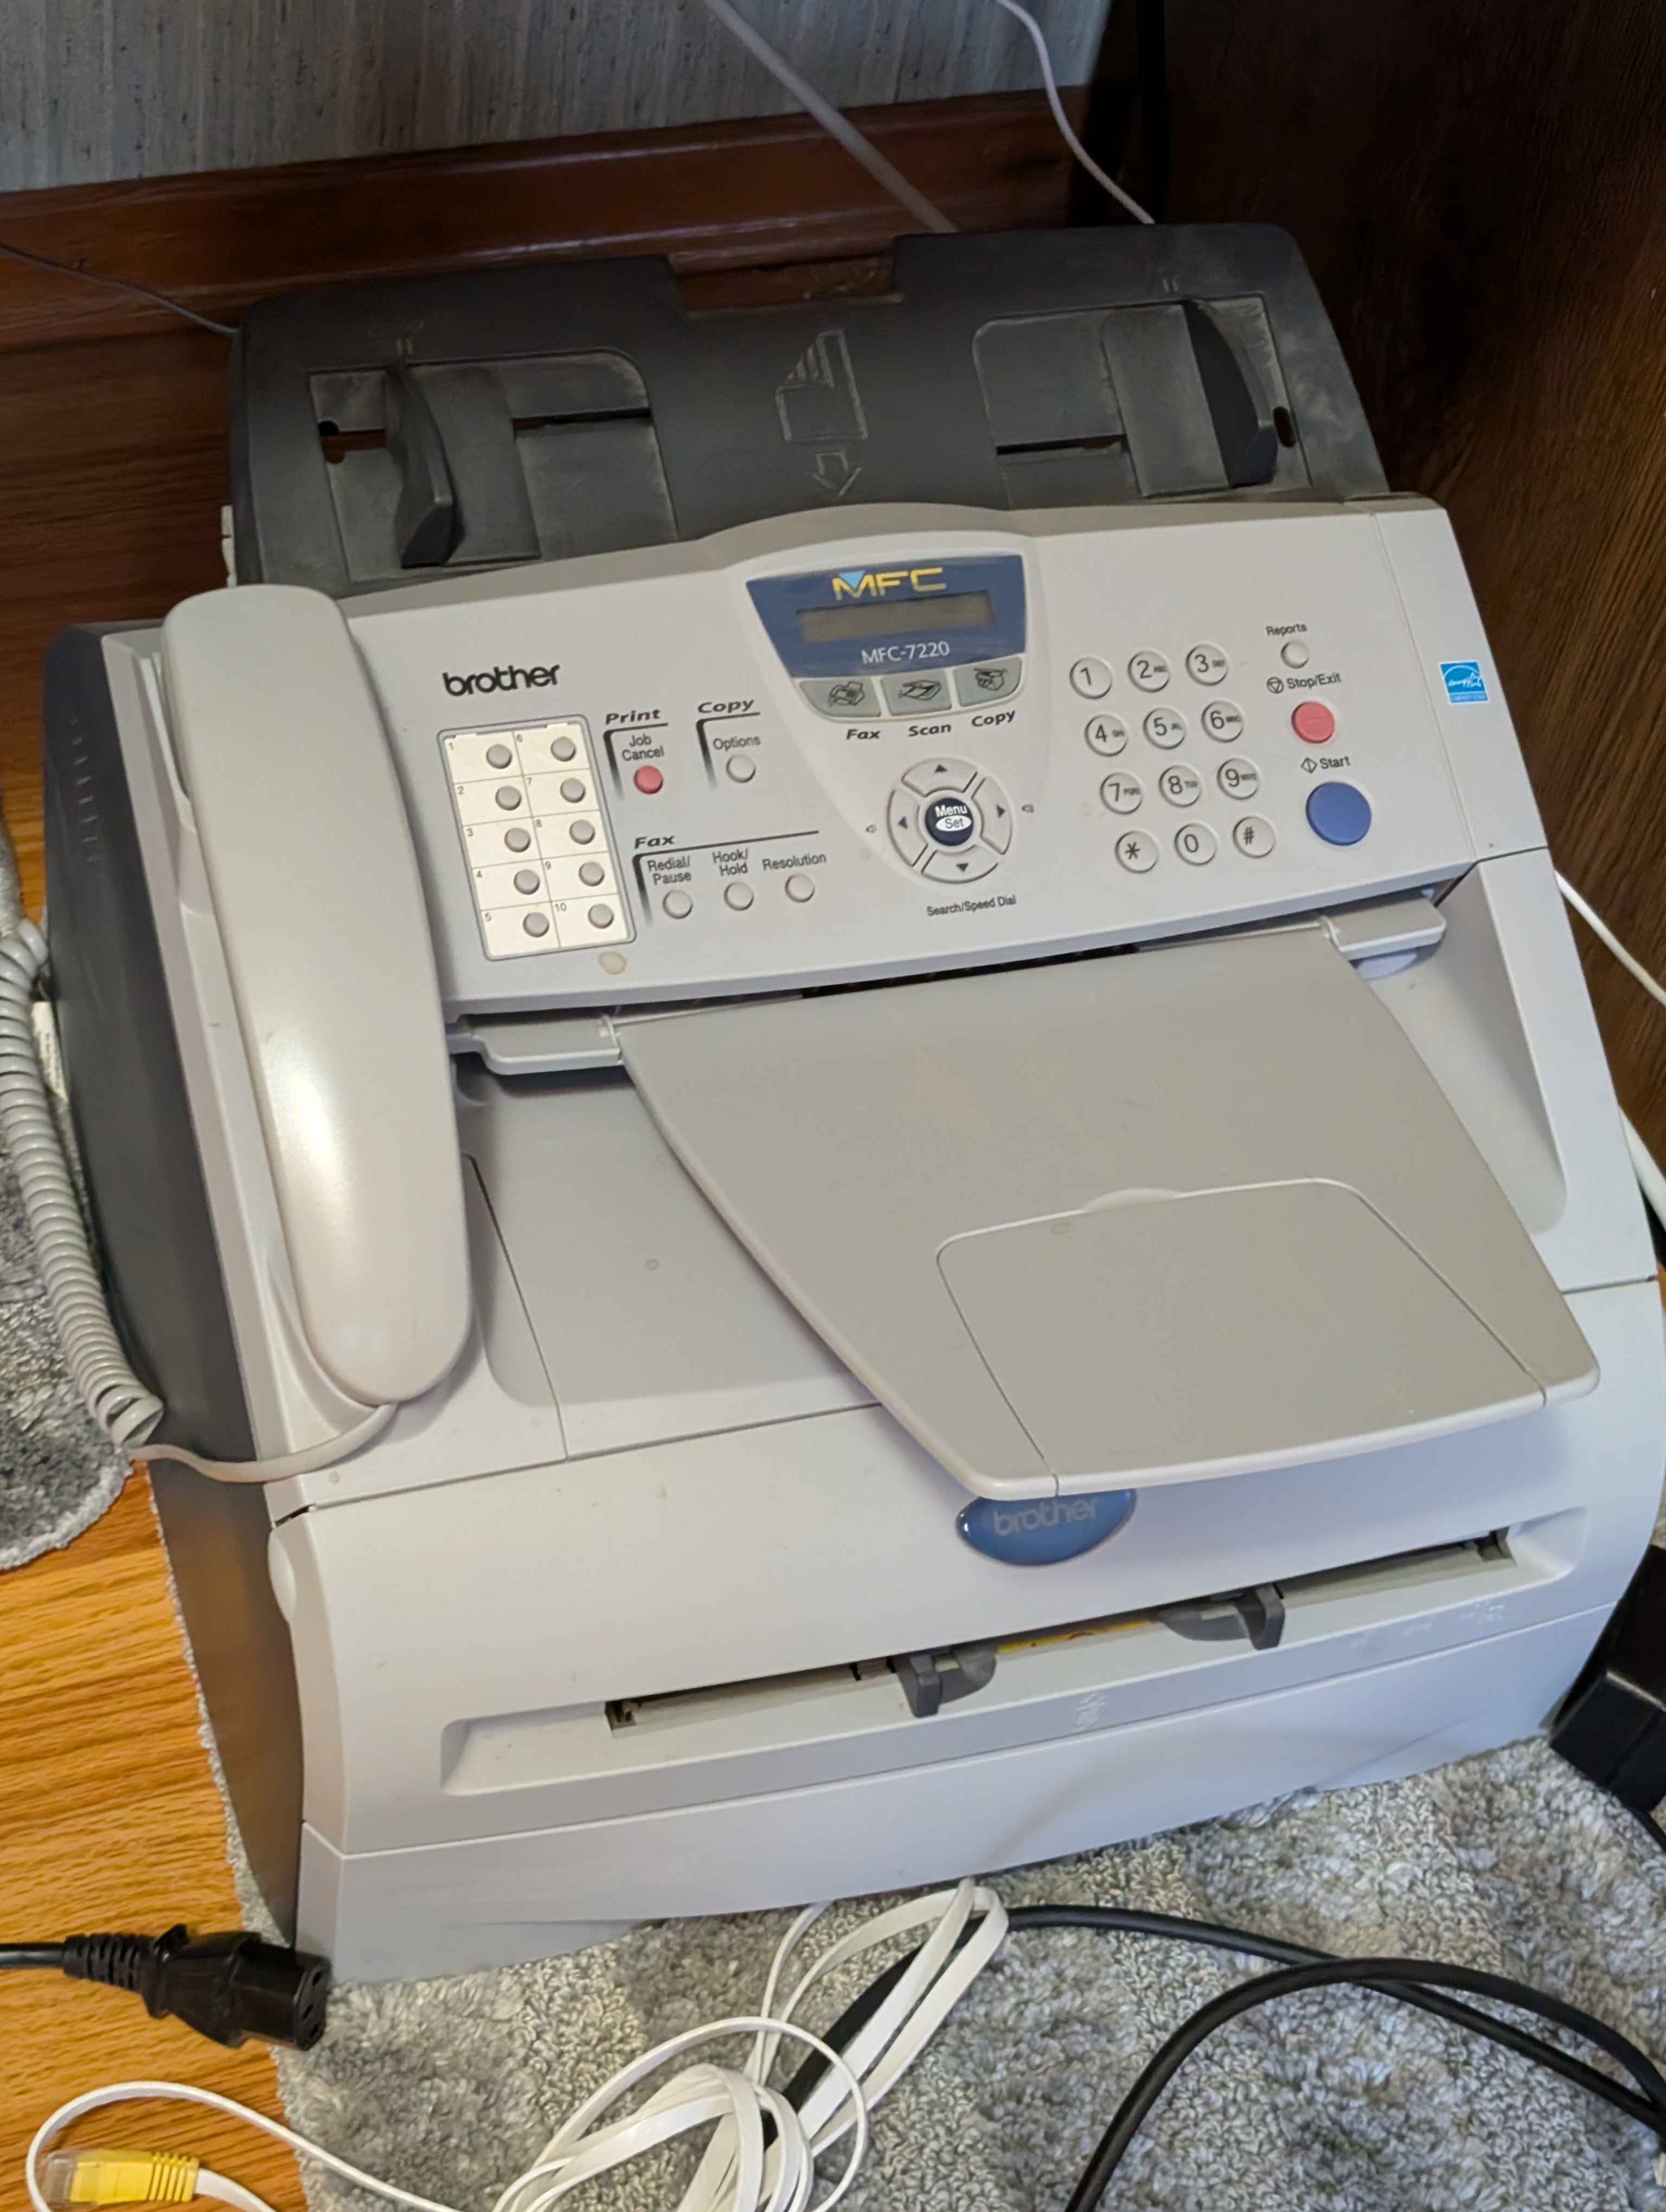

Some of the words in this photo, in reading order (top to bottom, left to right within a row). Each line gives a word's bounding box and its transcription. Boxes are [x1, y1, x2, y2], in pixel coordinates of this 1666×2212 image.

[832, 567, 947, 600] MFC
[1266, 623, 1308, 637] Reports
[861, 641, 950, 665] MFC-7220
[1137, 660, 1152, 678] 2
[1195, 654, 1209, 673] 3
[442, 665, 560, 696] brother
[1080, 667, 1091, 685] 1
[1286, 672, 1342, 690] Stop/Exit
[697, 699, 755, 713] Copy
[605, 709, 662, 725] Print
[971, 710, 1016, 728] Copy
[1210, 711, 1225, 730] 6
[845, 728, 881, 740] Fax
[908, 723, 951, 737] Scan
[1095, 724, 1107, 743] 4
[1154, 717, 1168, 736] 5
[448, 742, 454, 751] 1
[516, 734, 523, 743] 6
[629, 734, 652, 748] Job
[713, 735, 761, 752] Options
[621, 746, 664, 762] Cancel
[1319, 756, 1350, 770] Start
[527, 777, 533, 786] 7
[1168, 775, 1183, 794] 8
[1225, 768, 1240, 787] 9
[457, 786, 465, 795] 2
[1107, 782, 1120, 802] 7
[934, 805, 967, 818] Menu
[535, 819, 542, 828] 8
[945, 817, 964, 829] Set
[466, 828, 474, 837] 3
[1242, 826, 1255, 845] #
[634, 835, 675, 850] Fax
[1184, 833, 1199, 853] 0
[647, 856, 690, 872] Redial/
[712, 848, 748, 864] Hook/
[762, 852, 826, 871] Resolution
[544, 861, 552, 870] 9
[720, 862, 748, 876] Hold
[476, 870, 483, 879] 4
[653, 871, 692, 886] Pause
[554, 902, 567, 912] 10
[927, 897, 996, 917] Search/Speed
[997, 895, 1016, 906] Dial
[484, 912, 492, 922] 5
[993, 1497, 1099, 1536] brother
